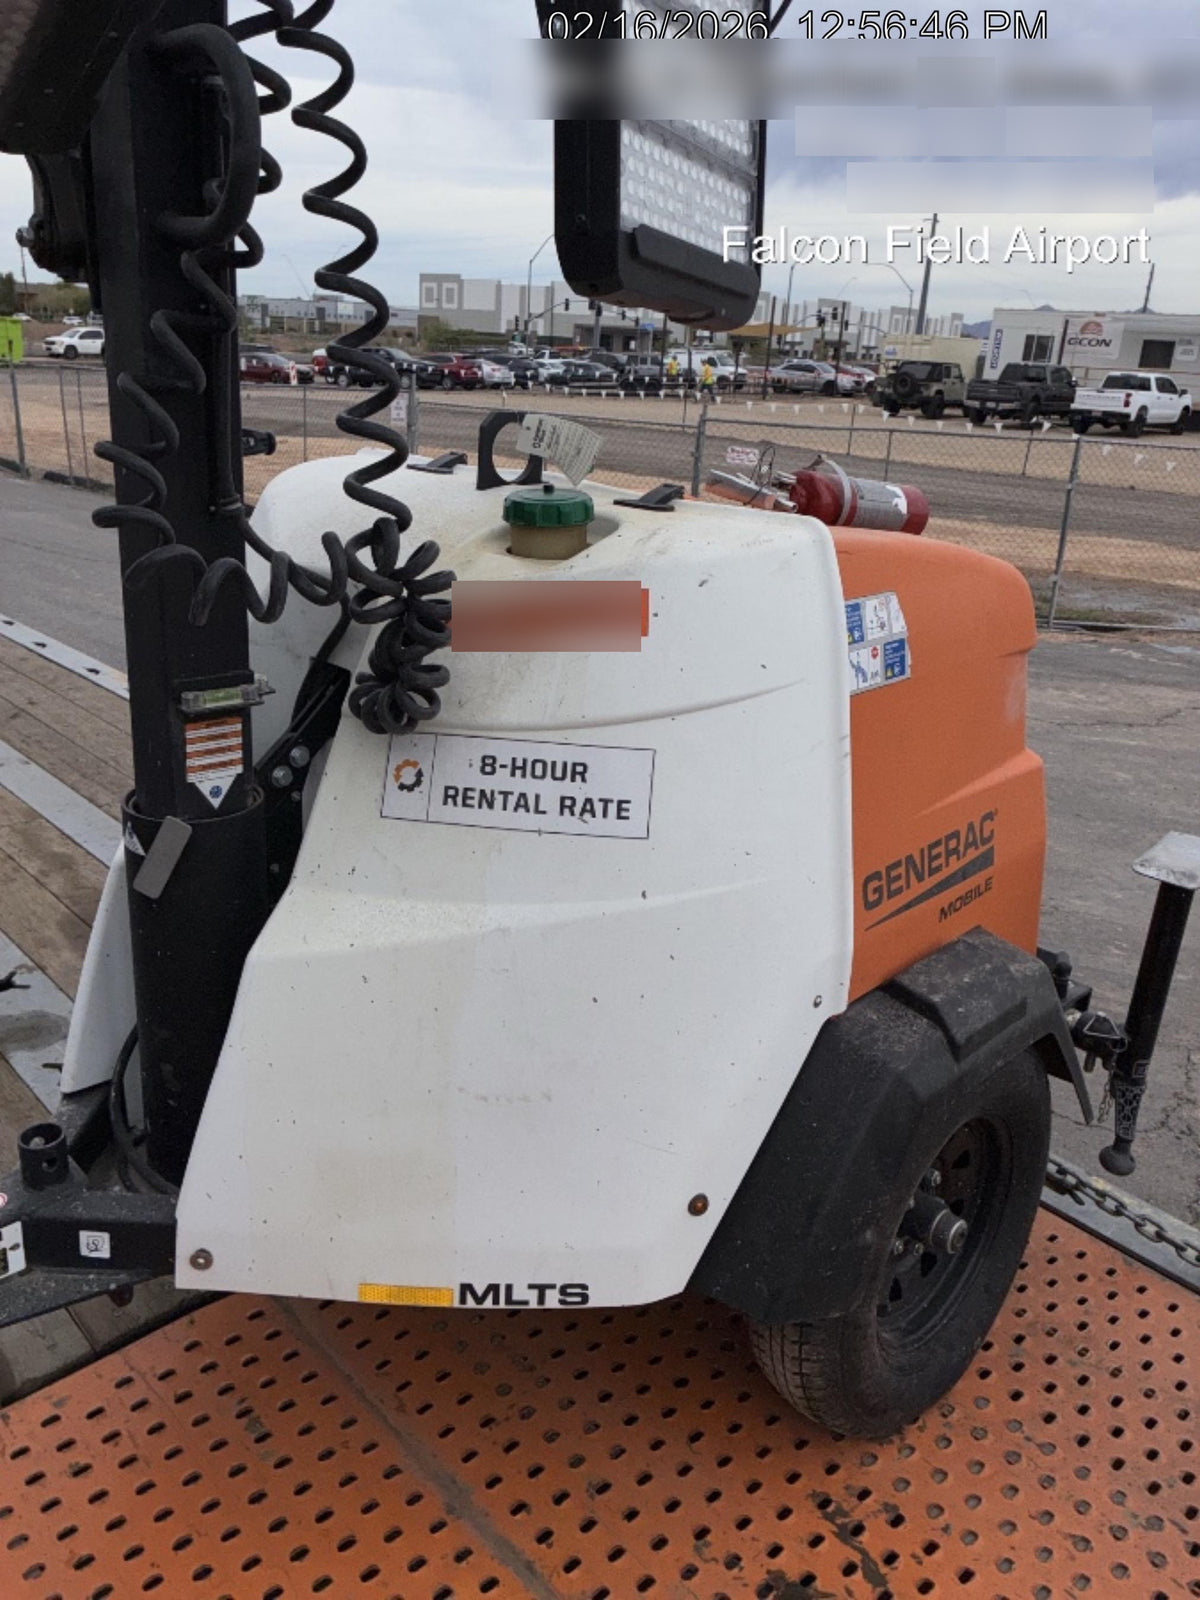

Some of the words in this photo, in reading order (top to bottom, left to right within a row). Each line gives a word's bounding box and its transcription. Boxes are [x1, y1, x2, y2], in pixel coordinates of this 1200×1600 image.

[479, 754, 589, 784] 8-HOUR
[441, 785, 548, 816] RENTAL
[558, 795, 633, 821] RATE
[862, 810, 996, 912] GENERAC
[938, 876, 994, 924] MOBILE
[458, 1283, 590, 1306] MLTS
